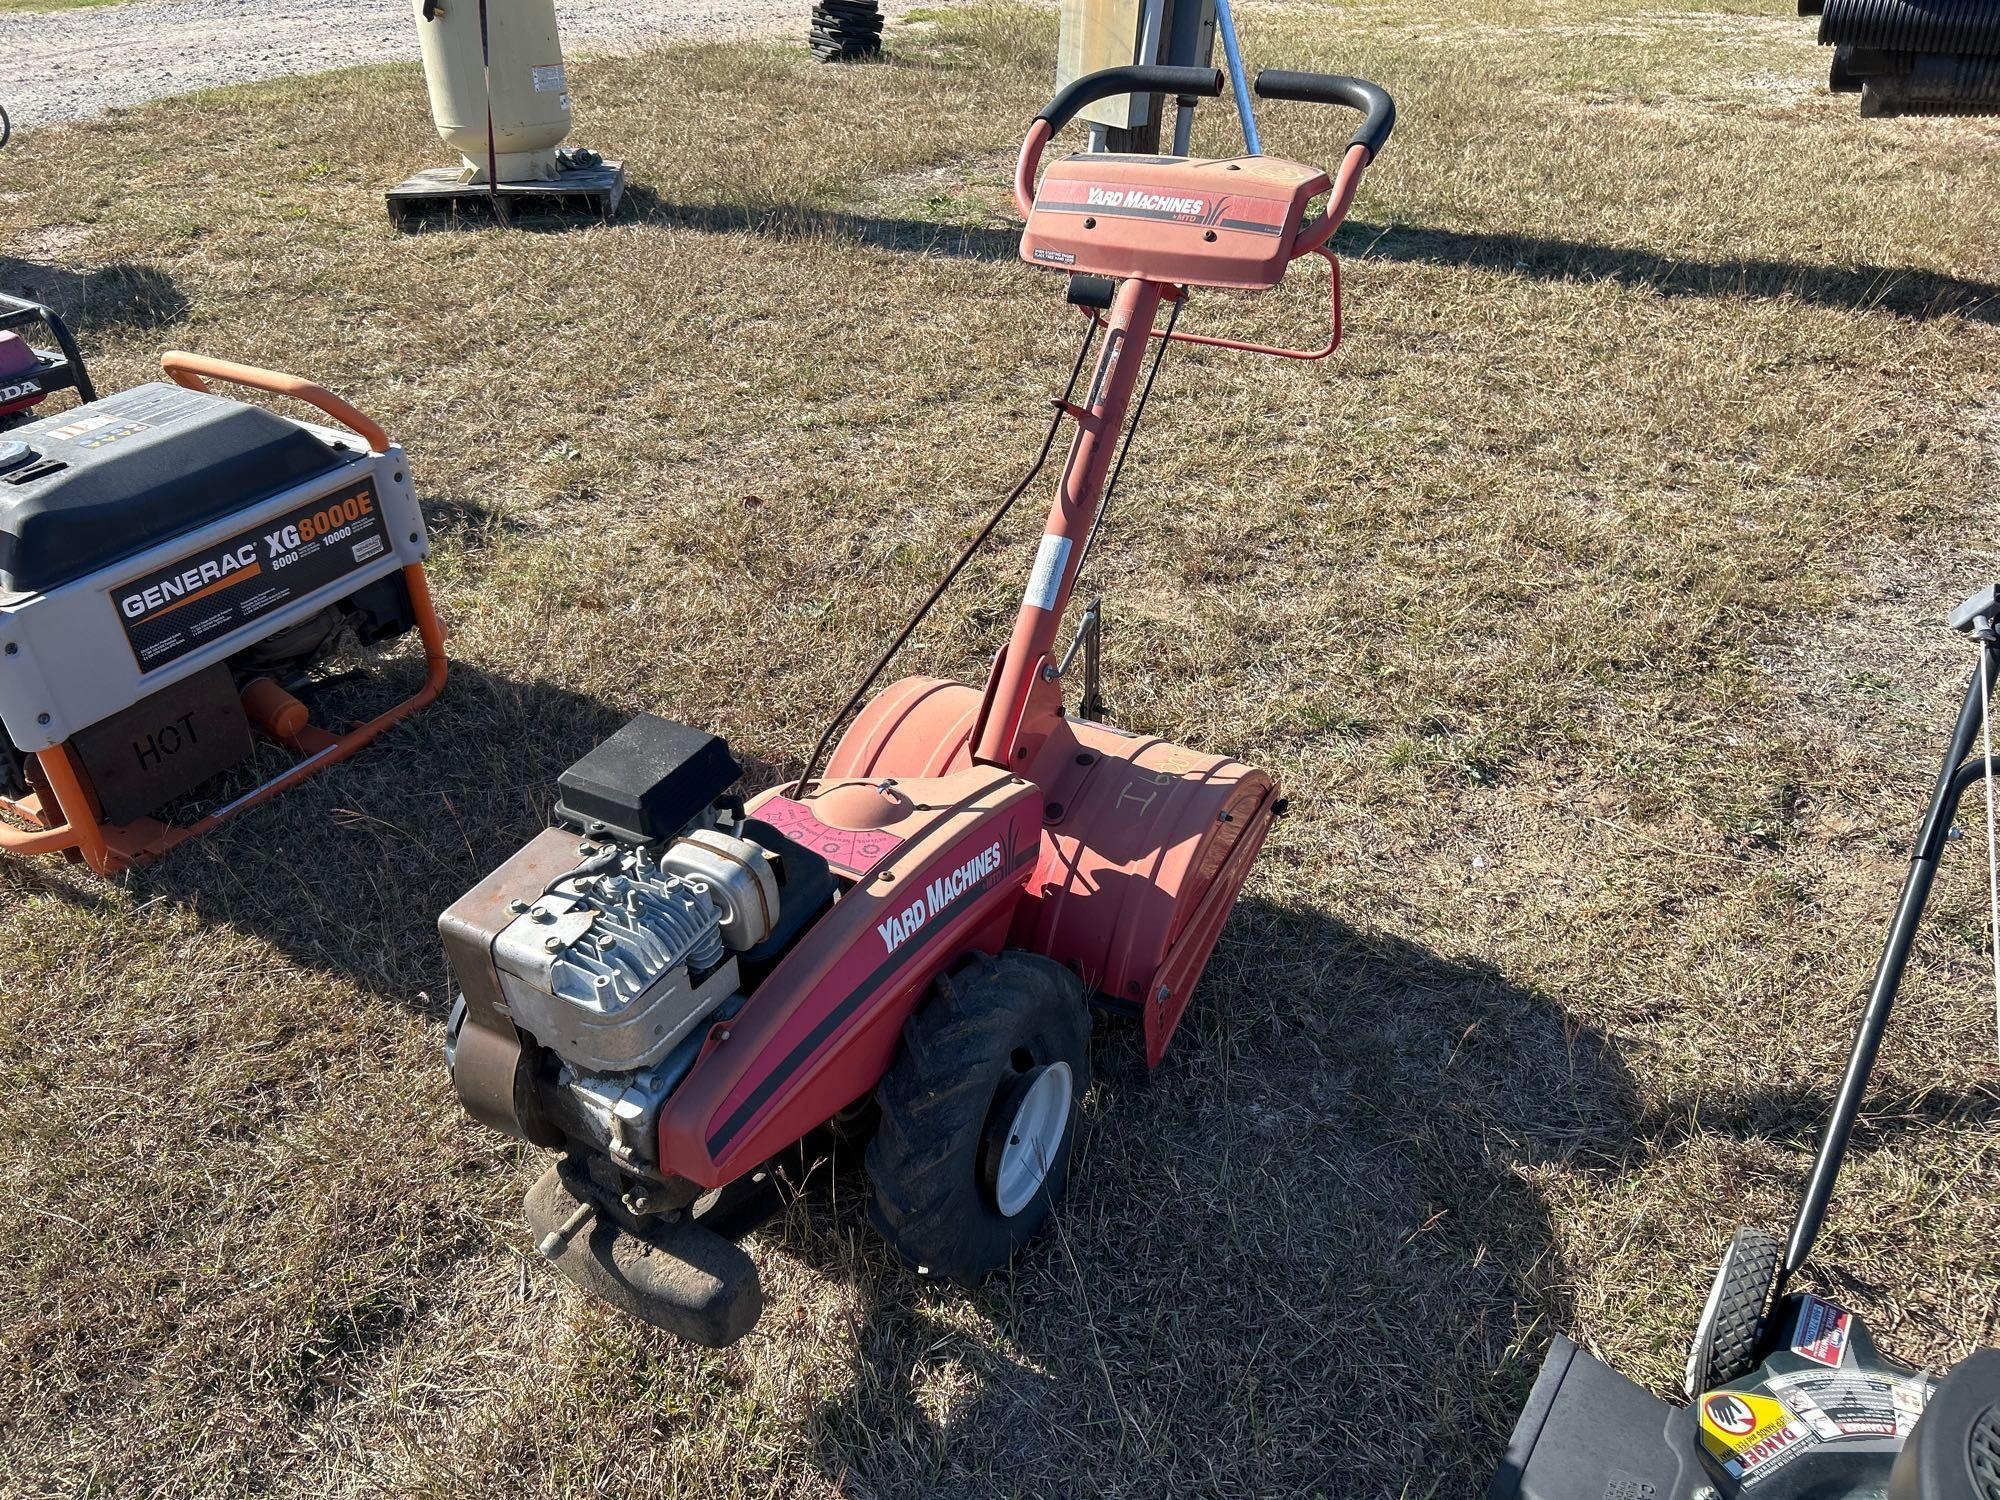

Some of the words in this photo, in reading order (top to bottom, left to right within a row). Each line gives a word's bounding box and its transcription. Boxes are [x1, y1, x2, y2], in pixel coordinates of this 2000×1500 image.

[1086, 187, 1123, 206] YARD
[1122, 191, 1204, 214] MACHINES
[1177, 214, 1197, 223] MTD
[264, 490, 374, 558] XG8000E
[272, 551, 299, 571] 8000
[323, 526, 352, 547] 10000
[121, 544, 257, 619] GENERAC
[132, 712, 202, 772] HOT
[877, 899, 926, 954] YARD
[926, 841, 1001, 918] MACHINES
[1733, 1436, 1746, 1452] FEET
[1734, 1427, 1797, 1470] DANGER
[1756, 1421, 1776, 1439] HANDS
